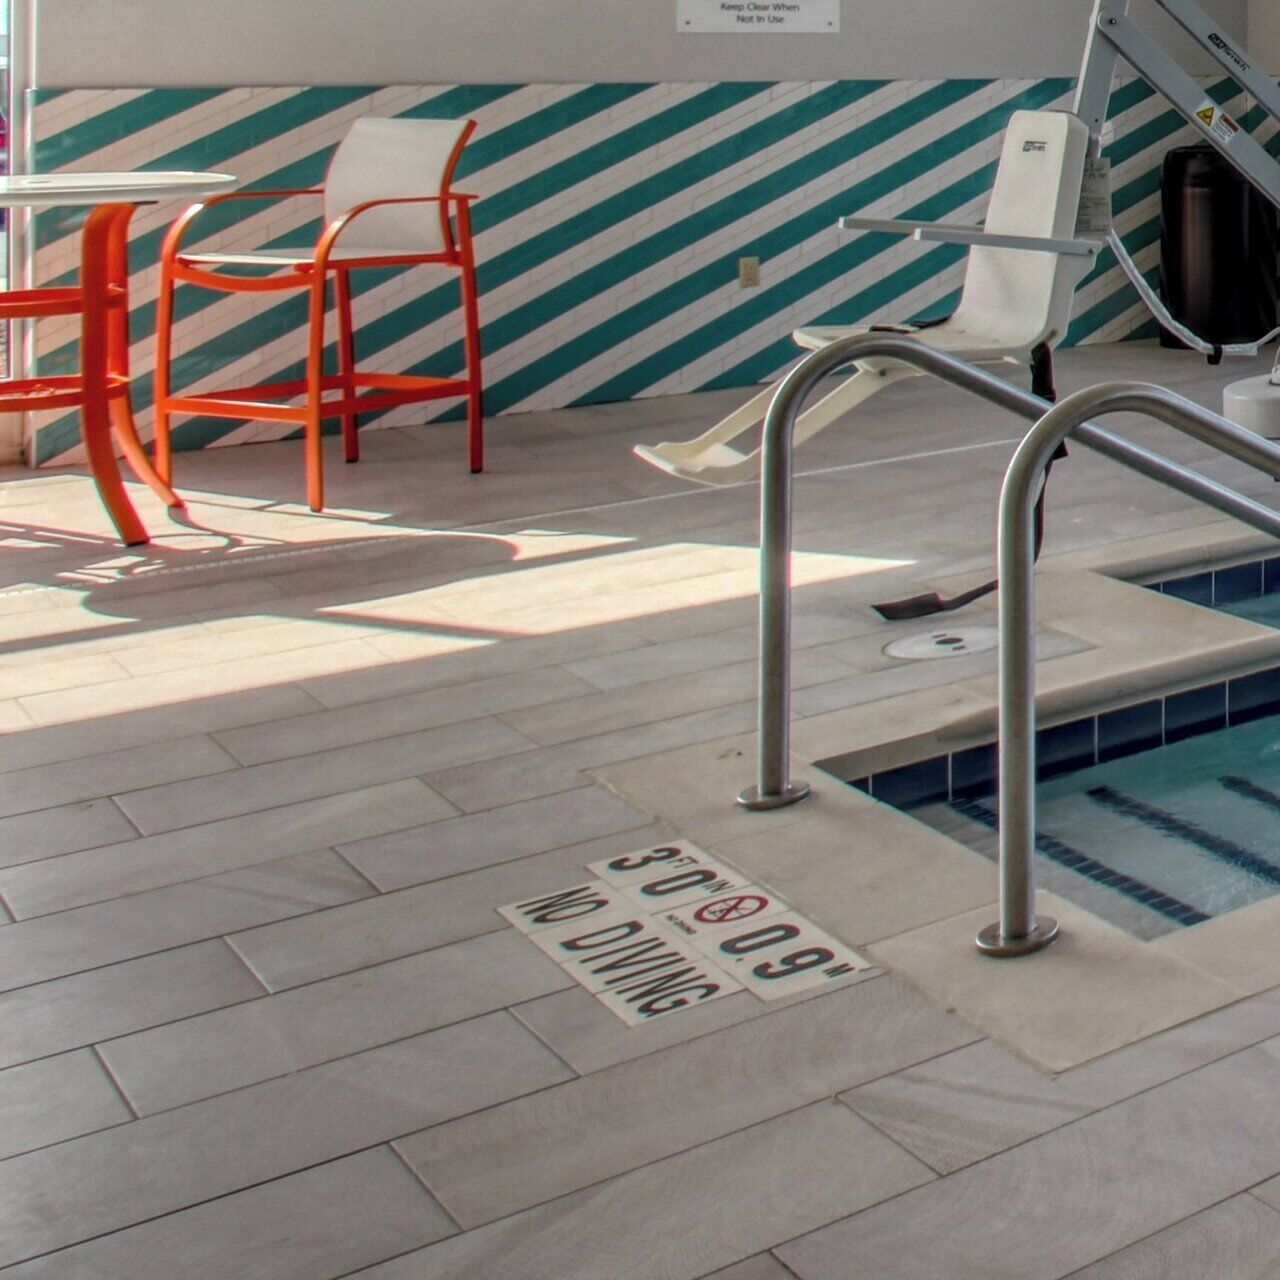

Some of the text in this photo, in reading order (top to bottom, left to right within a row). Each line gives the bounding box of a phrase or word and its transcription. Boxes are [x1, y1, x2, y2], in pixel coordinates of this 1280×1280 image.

[720, 2, 800, 13] Keep Clear When
[735, 14, 785, 24] Not In Use
[608, 846, 682, 872] 3
[666, 855, 699, 869] FT
[640, 869, 718, 897] 0
[515, 885, 721, 1018] NO DIVING
